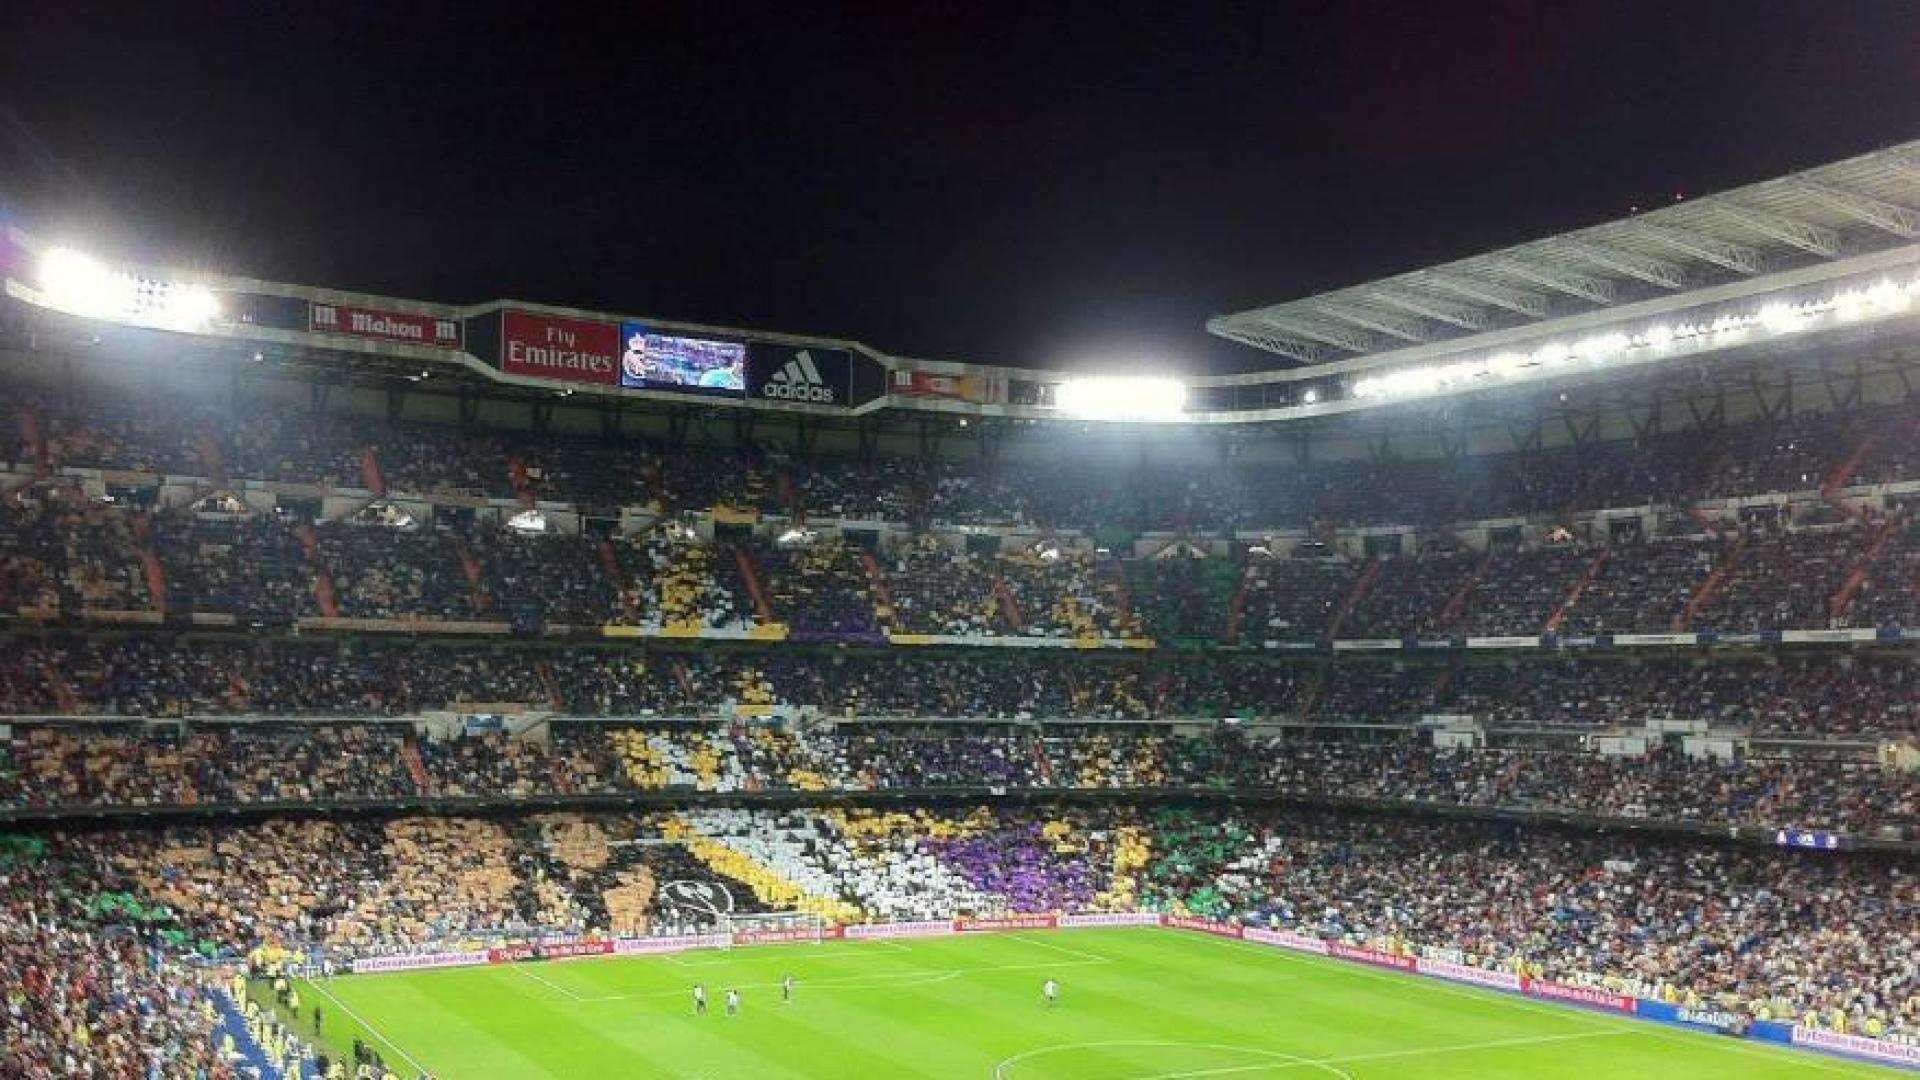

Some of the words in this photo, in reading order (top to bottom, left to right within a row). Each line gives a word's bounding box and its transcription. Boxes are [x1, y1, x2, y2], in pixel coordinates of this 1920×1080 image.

[547, 327, 575, 348] Fly
[509, 341, 612, 372] Emirates
[764, 381, 834, 403] adidas
